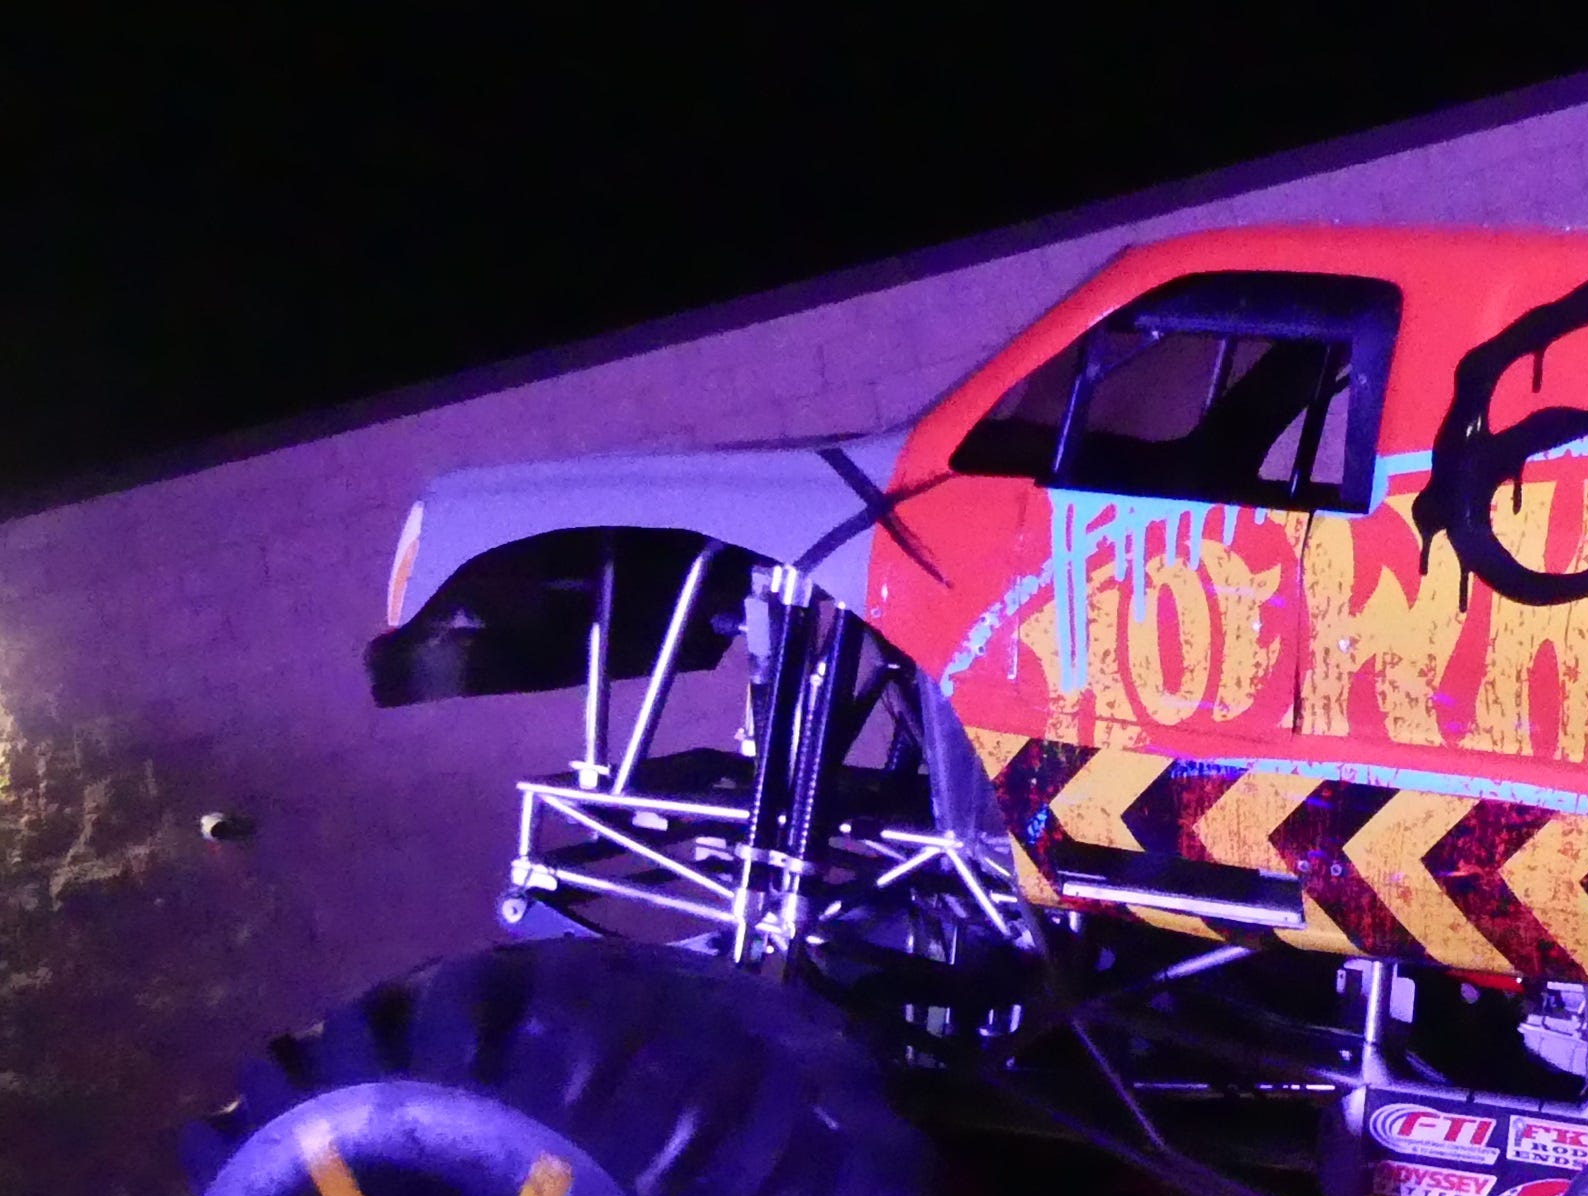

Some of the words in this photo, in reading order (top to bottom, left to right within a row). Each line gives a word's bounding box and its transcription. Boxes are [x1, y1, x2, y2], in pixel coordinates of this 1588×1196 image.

[1397, 1111, 1493, 1146] FTI
[1522, 1123, 1588, 1148] FK
[1513, 1149, 1588, 1168] ENDS
[1531, 1142, 1588, 1158] ROD
